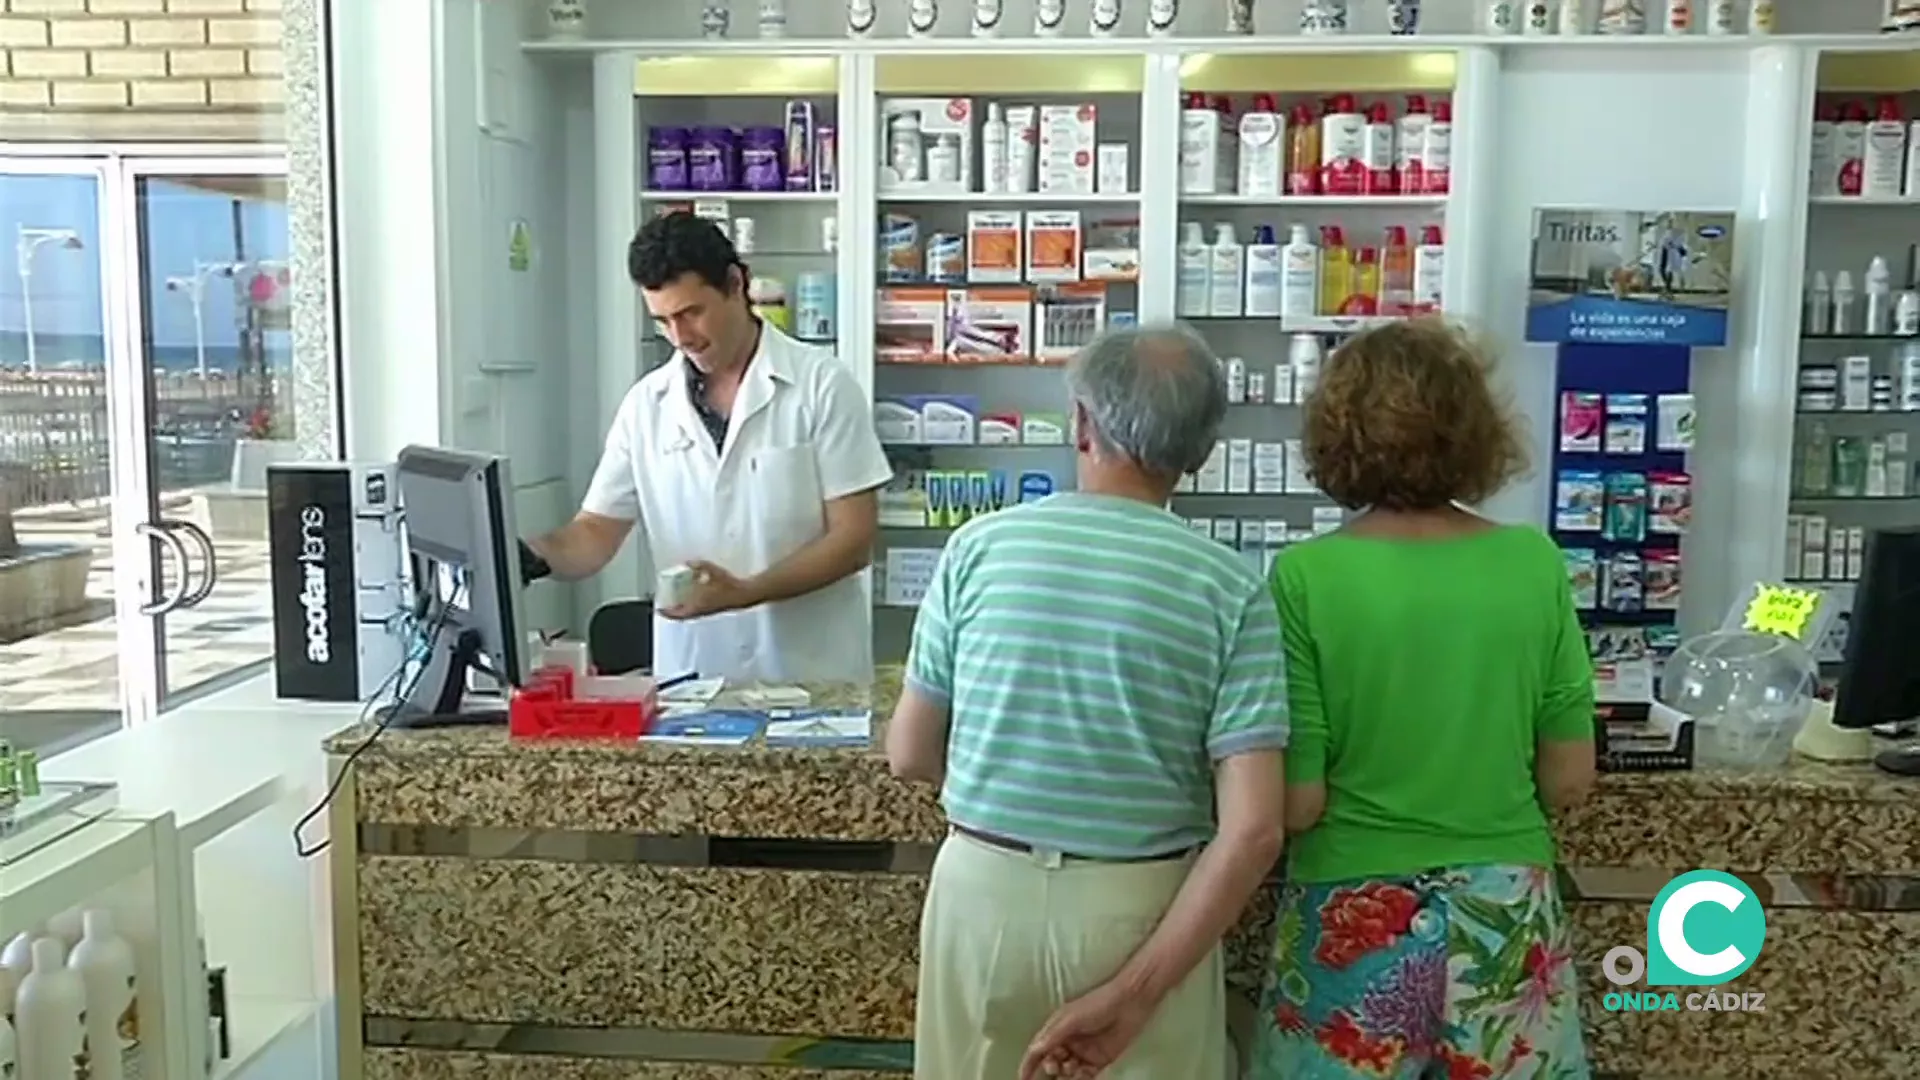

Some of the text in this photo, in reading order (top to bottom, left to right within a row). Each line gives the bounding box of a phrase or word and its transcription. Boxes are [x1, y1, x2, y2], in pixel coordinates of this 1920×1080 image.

[1570, 311, 1586, 325] La
[1589, 311, 1615, 325] vida
[1618, 315, 1631, 325] es
[1634, 315, 1658, 325] una
[1570, 326, 1586, 336] de
